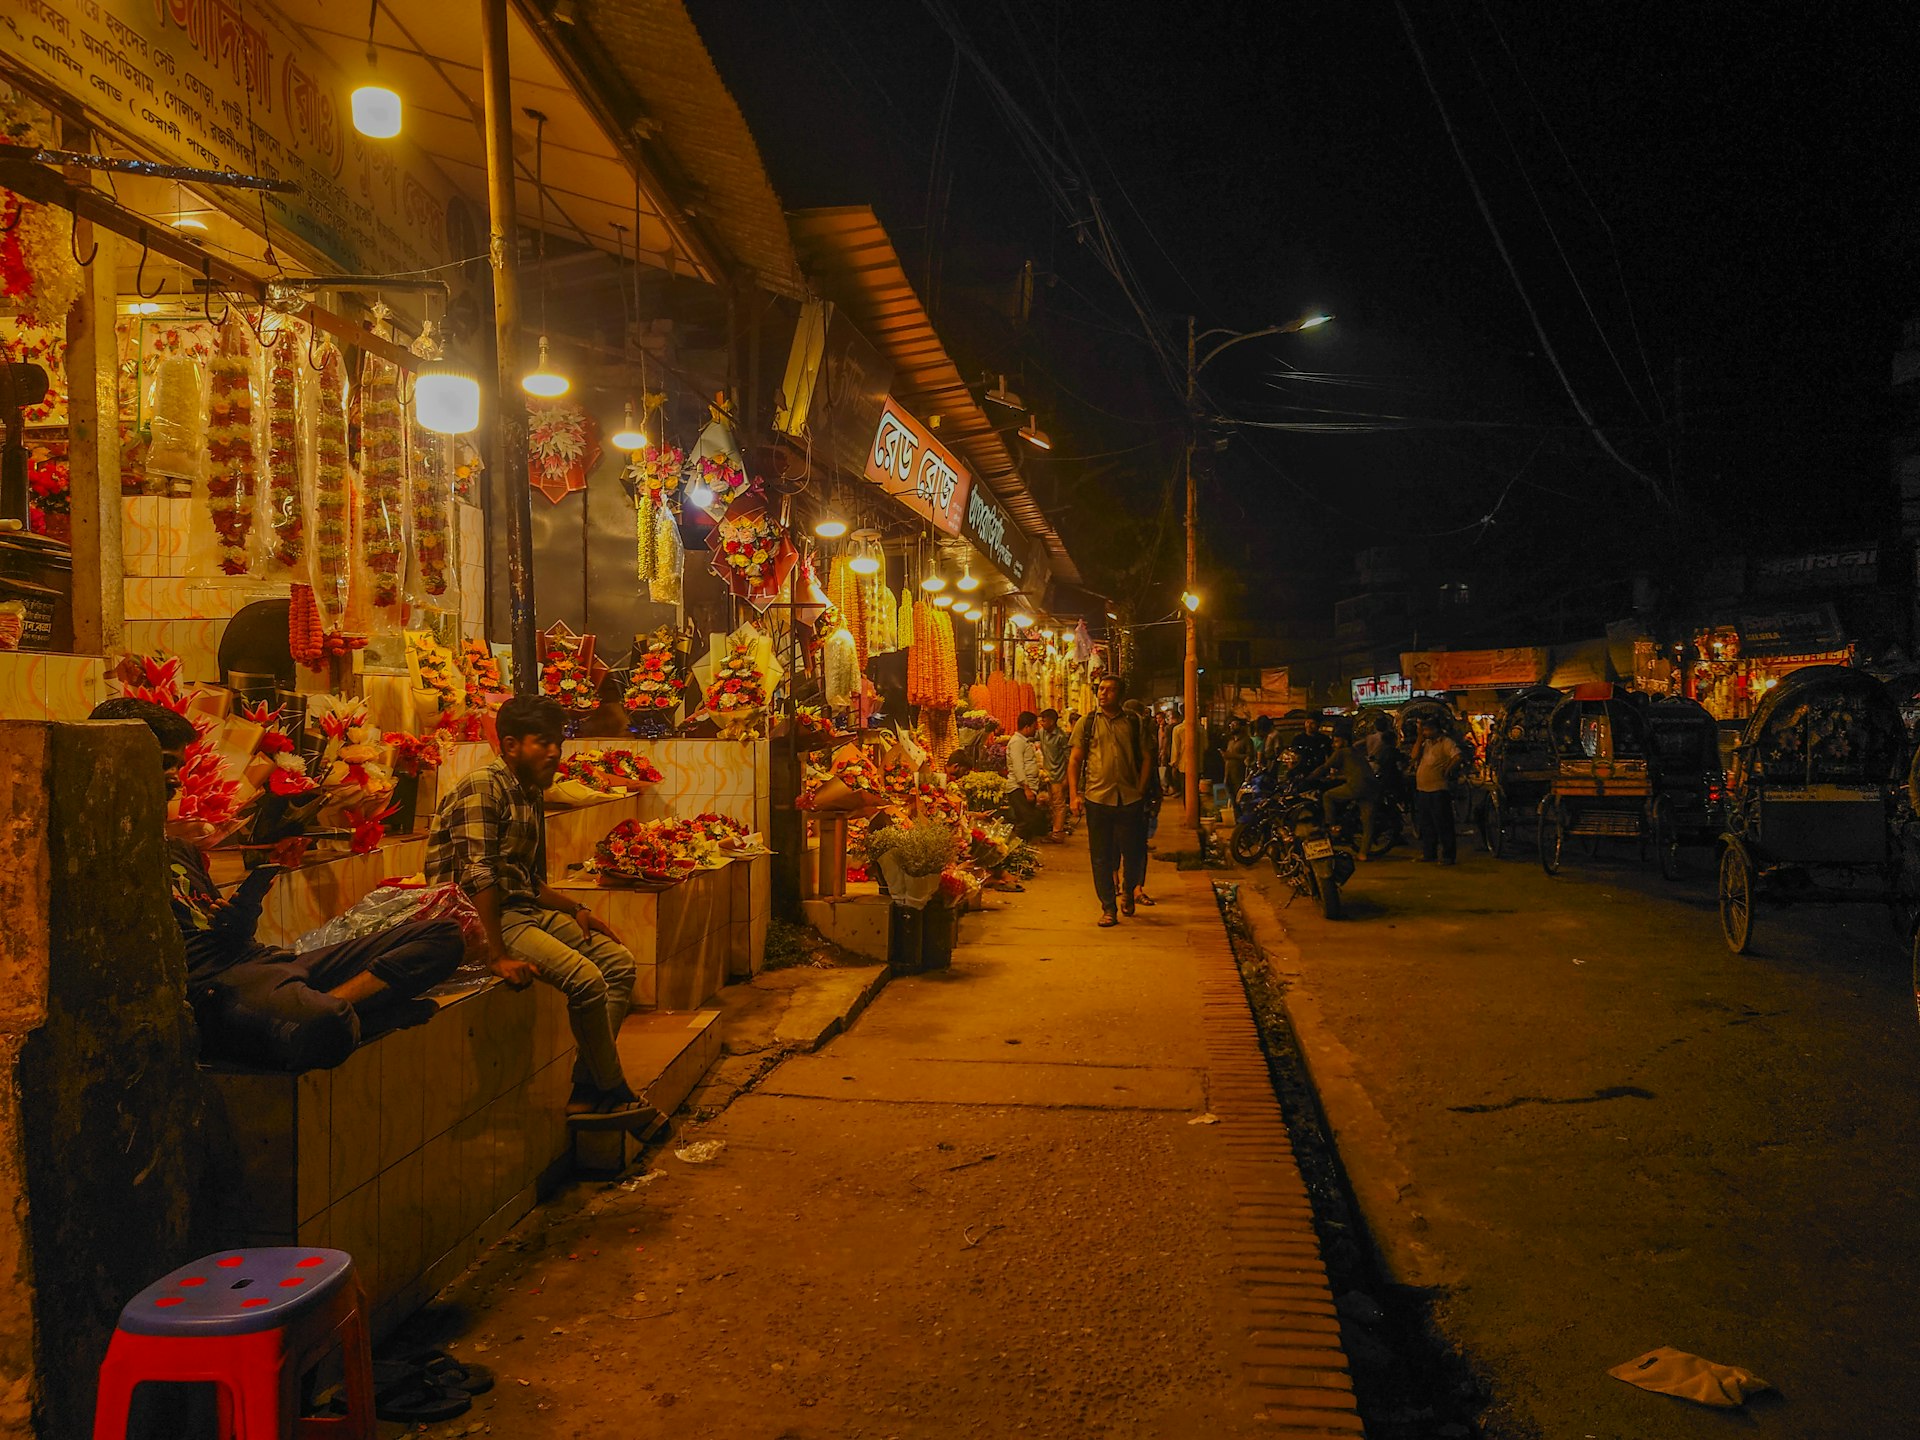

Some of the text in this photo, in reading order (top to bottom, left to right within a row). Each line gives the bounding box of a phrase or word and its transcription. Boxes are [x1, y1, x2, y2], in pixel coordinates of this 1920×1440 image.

[20, 0, 76, 48] ারবেরা,
[164, 90, 207, 138] গোলাপ,
[104, 10, 148, 59] হলুদের
[32, 35, 84, 79] মোমিন
[90, 74, 123, 102] রোড
[141, 108, 181, 142] চেরাগী
[186, 137, 221, 170] পাহাড়
[874, 410, 919, 481] রেড
[917, 448, 958, 519] রোজ
